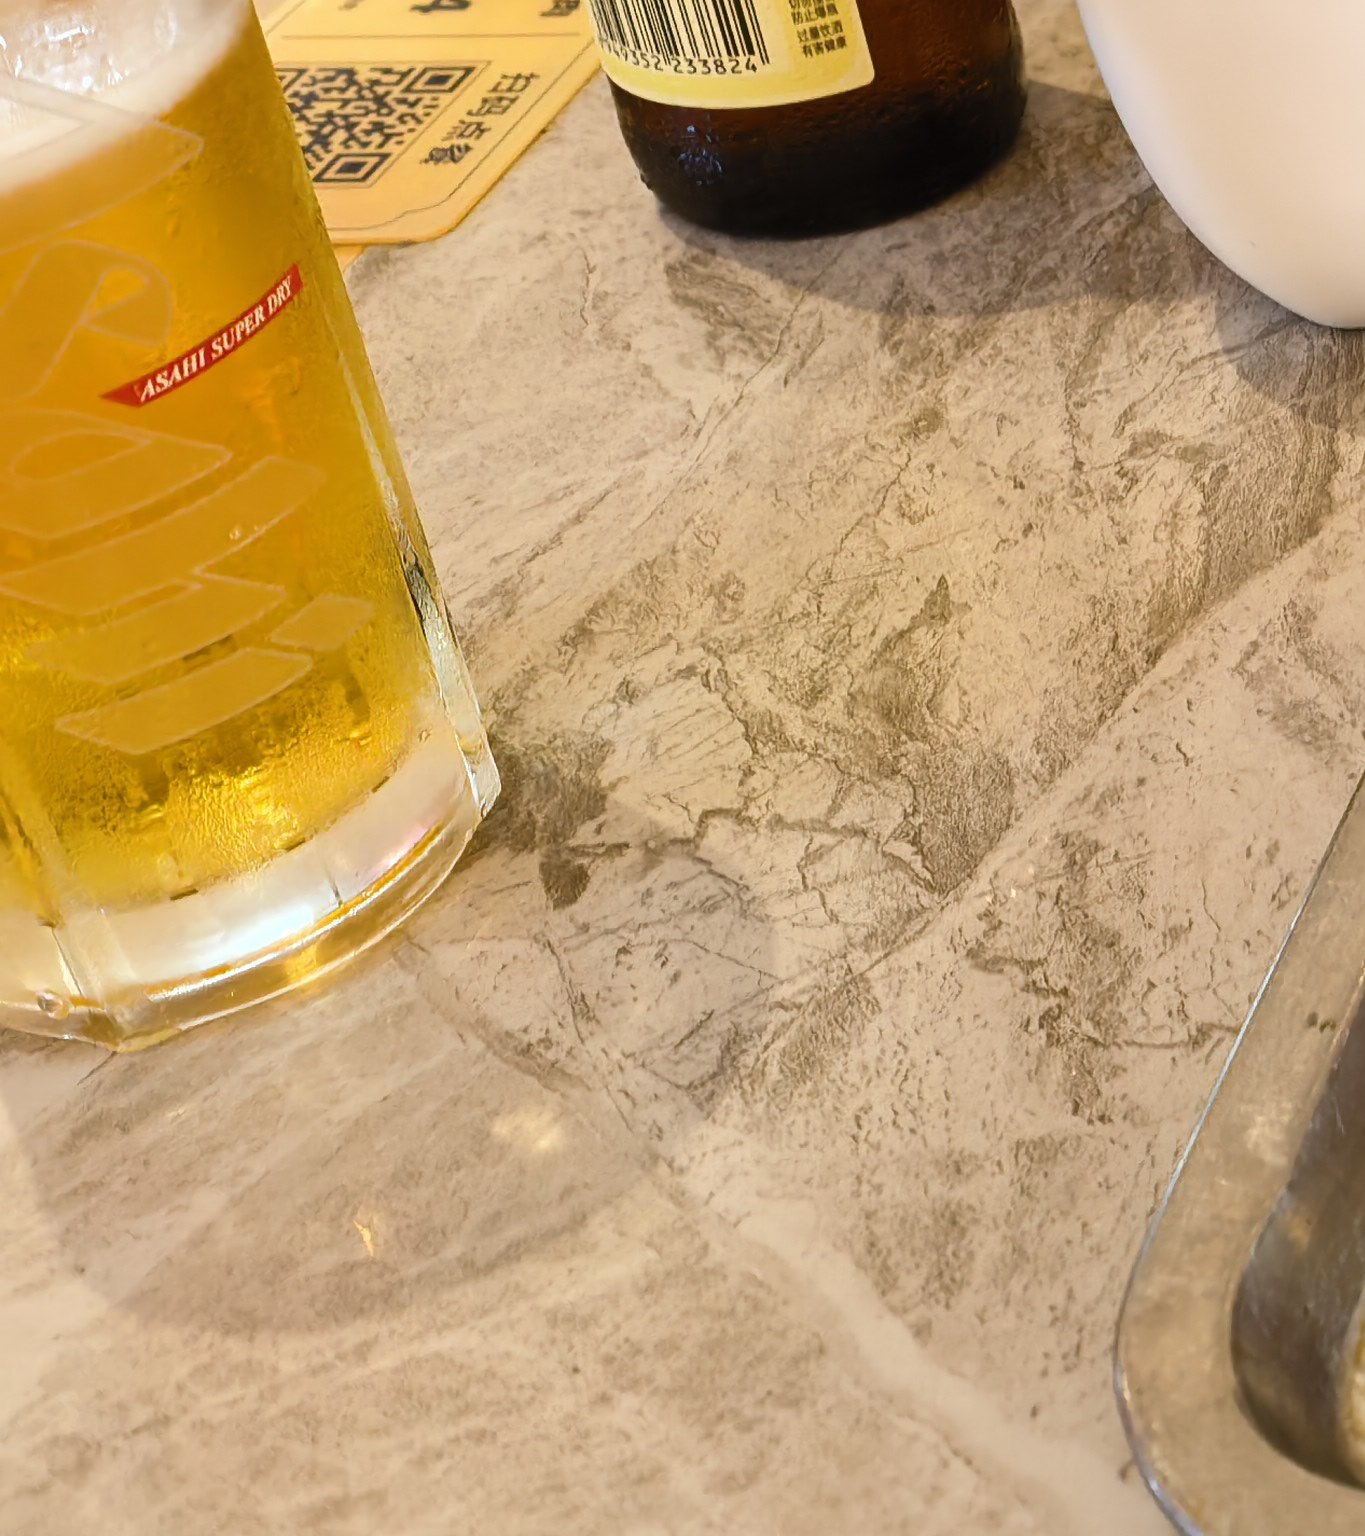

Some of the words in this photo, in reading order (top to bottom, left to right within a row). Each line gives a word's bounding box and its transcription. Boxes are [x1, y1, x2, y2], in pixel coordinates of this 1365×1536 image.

[670, 57, 758, 75] 233824
[140, 347, 207, 403] ASAHI
[210, 304, 266, 361] SUPER
[266, 274, 293, 316] DRY
